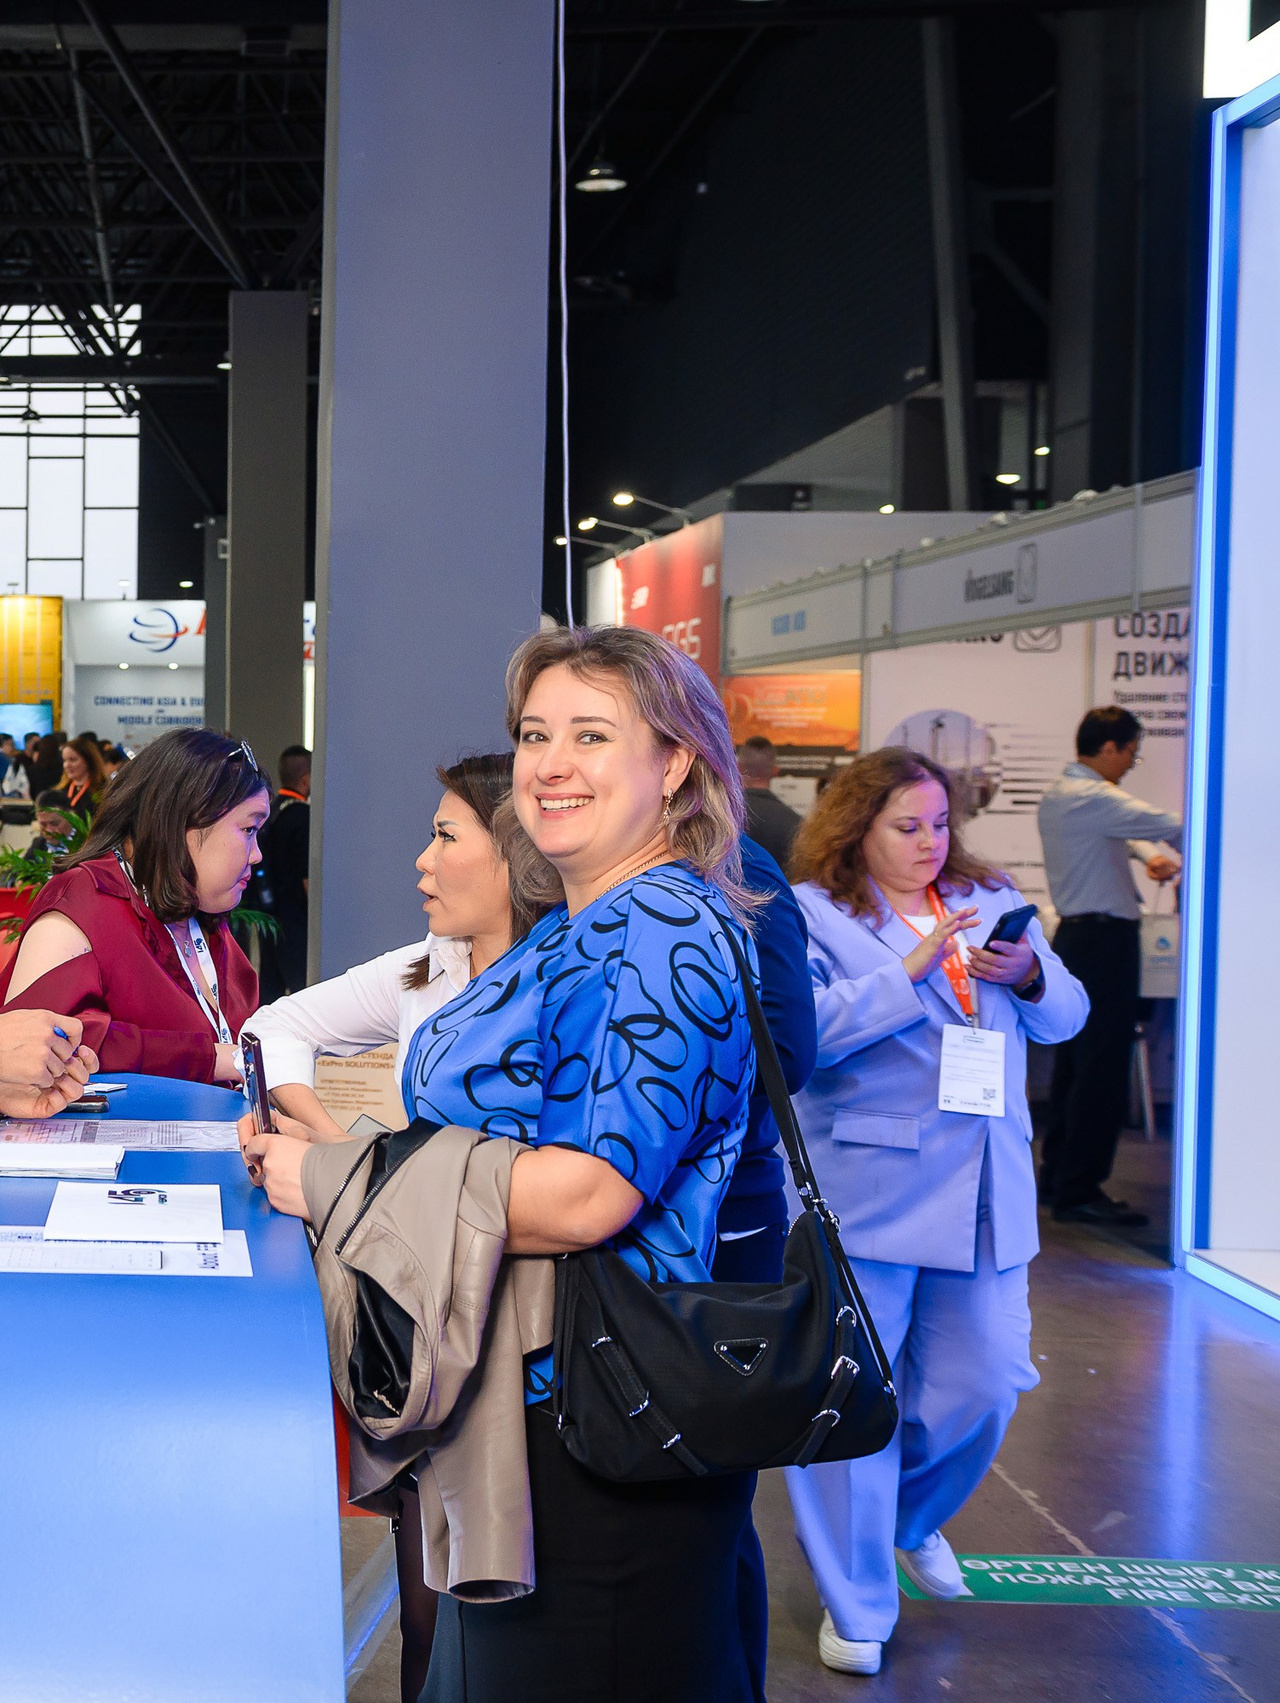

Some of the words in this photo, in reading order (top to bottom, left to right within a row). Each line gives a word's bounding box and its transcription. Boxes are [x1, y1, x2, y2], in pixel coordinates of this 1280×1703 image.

[93, 696, 153, 706] CONNECTING
[157, 696, 177, 706] ASIA
[117, 716, 152, 725] MIDDLE
[988, 1572, 1226, 1592] ПОЖАРНЫЙ
[1103, 1587, 1201, 1603] FIRE
